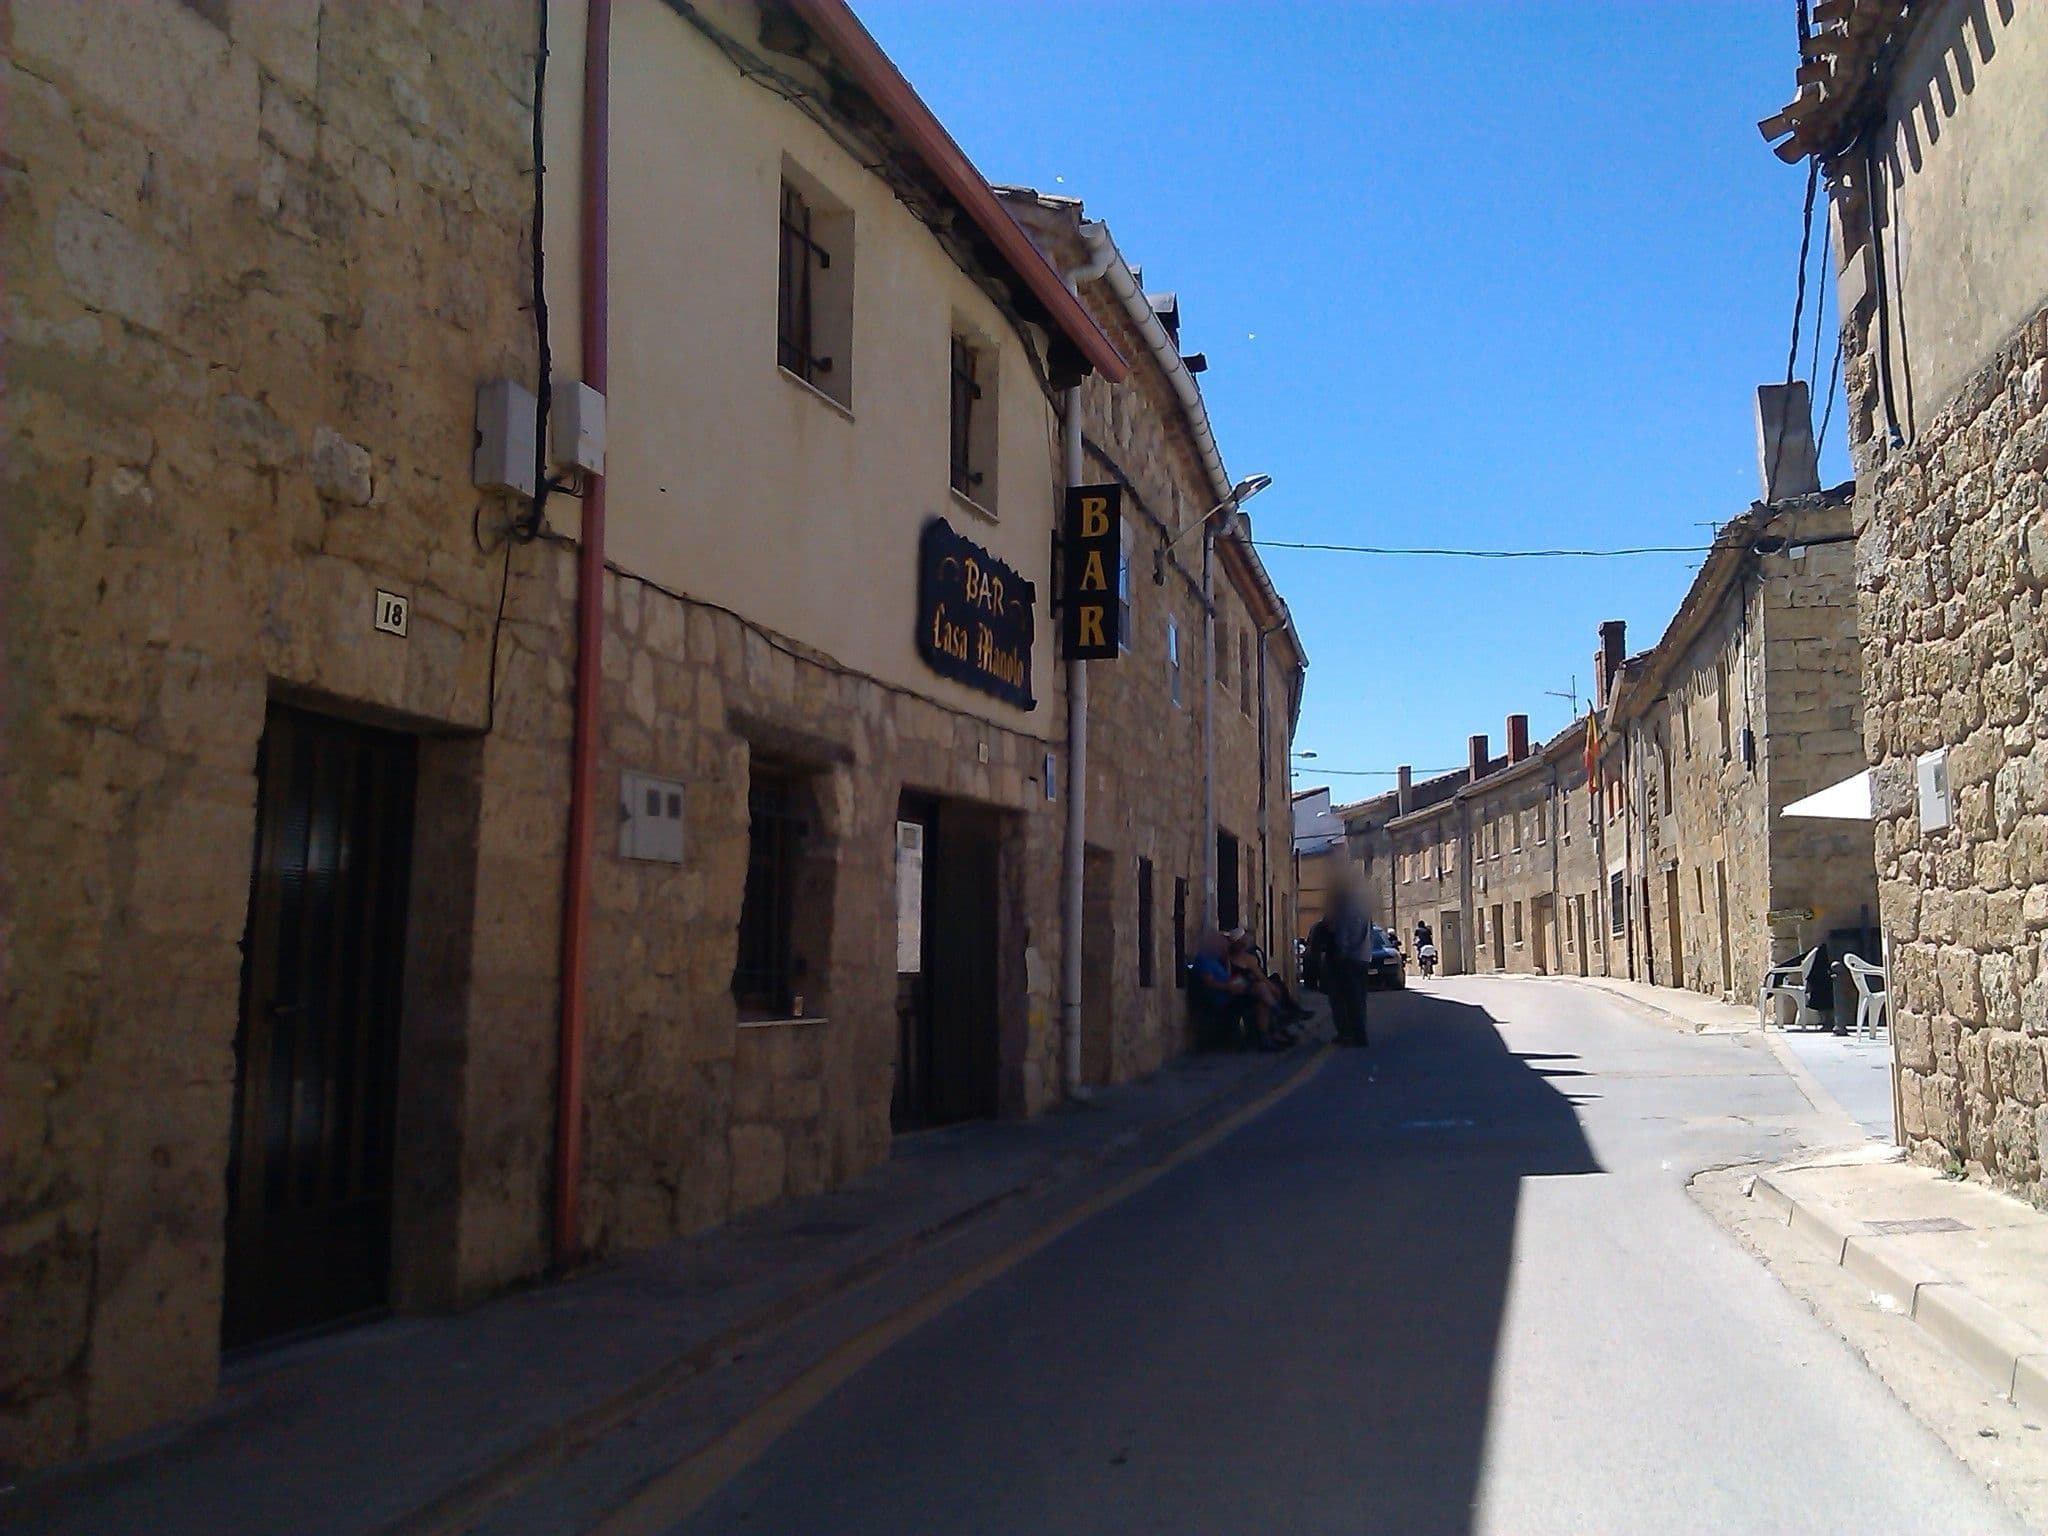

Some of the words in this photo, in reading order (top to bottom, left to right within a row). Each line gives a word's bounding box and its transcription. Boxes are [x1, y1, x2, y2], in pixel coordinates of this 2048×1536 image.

[965, 558, 1004, 616] BAR
[1079, 497, 1109, 647] BAR
[383, 601, 402, 626] 18
[933, 603, 968, 661] Casa
